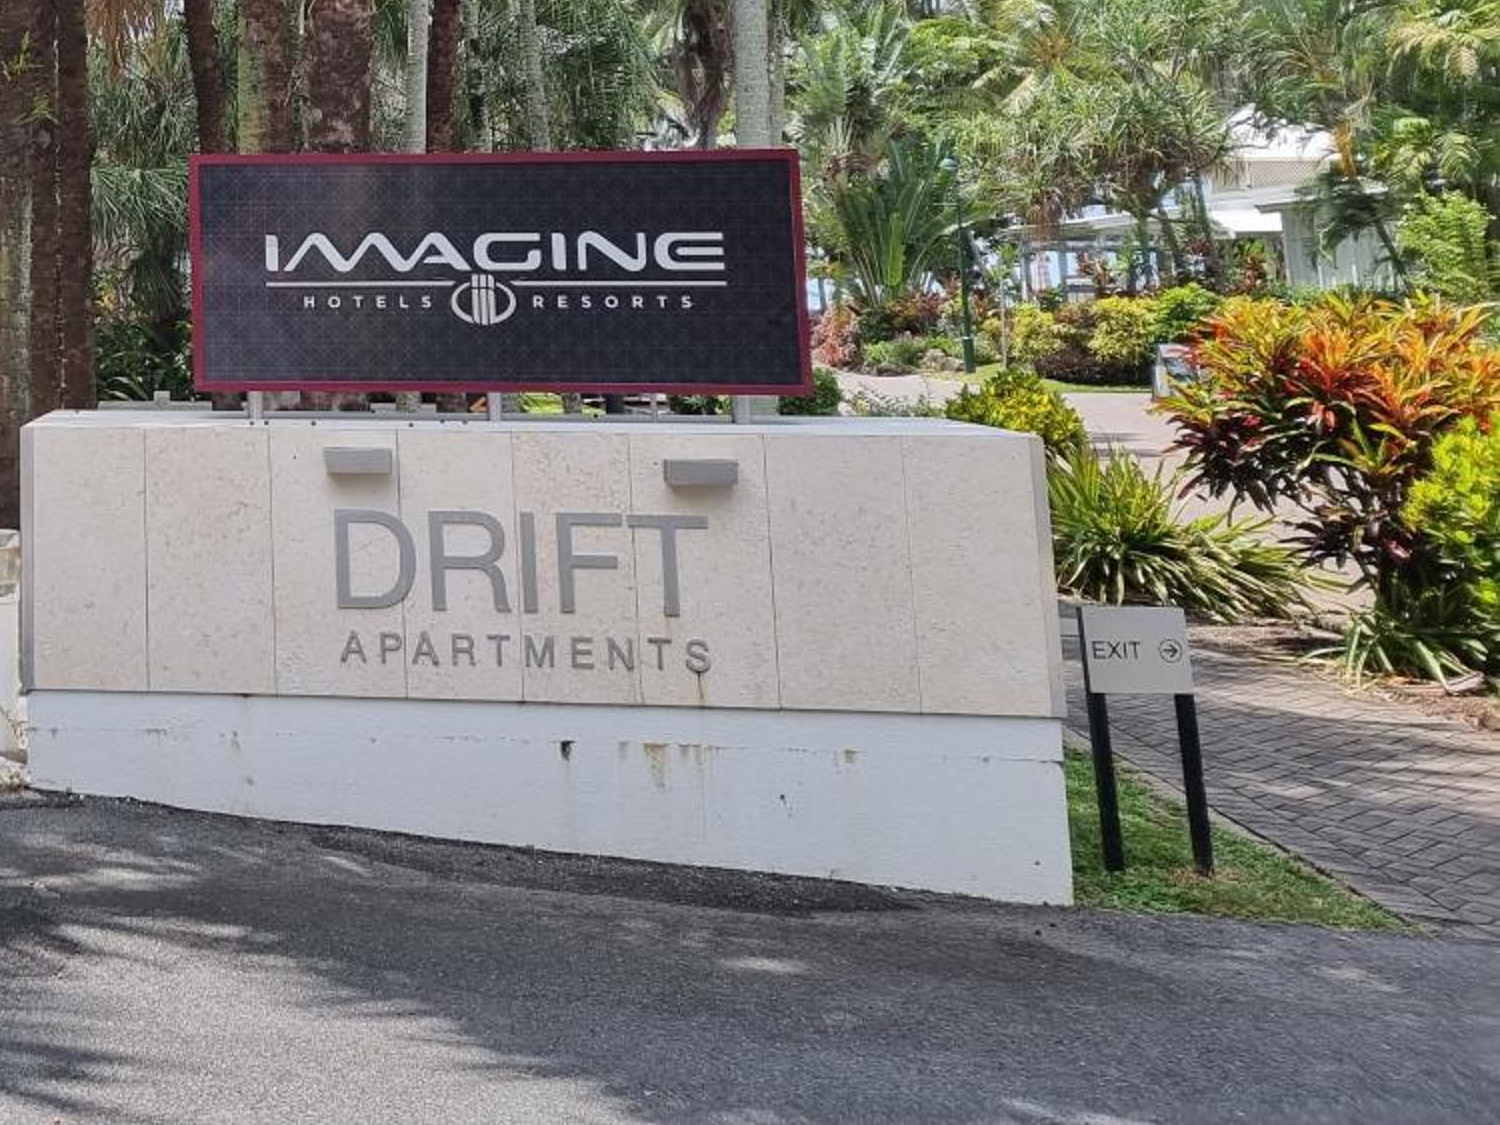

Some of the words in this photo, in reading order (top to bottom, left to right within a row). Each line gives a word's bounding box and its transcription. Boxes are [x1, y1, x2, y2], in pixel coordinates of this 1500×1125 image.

[265, 231, 725, 272] IMAGINE
[303, 296, 434, 309] HOTELS
[533, 295, 695, 308] RESORTS
[332, 508, 709, 618] DRIFT
[340, 630, 712, 674] APARTMENTS
[1091, 640, 1141, 660] EXIT
